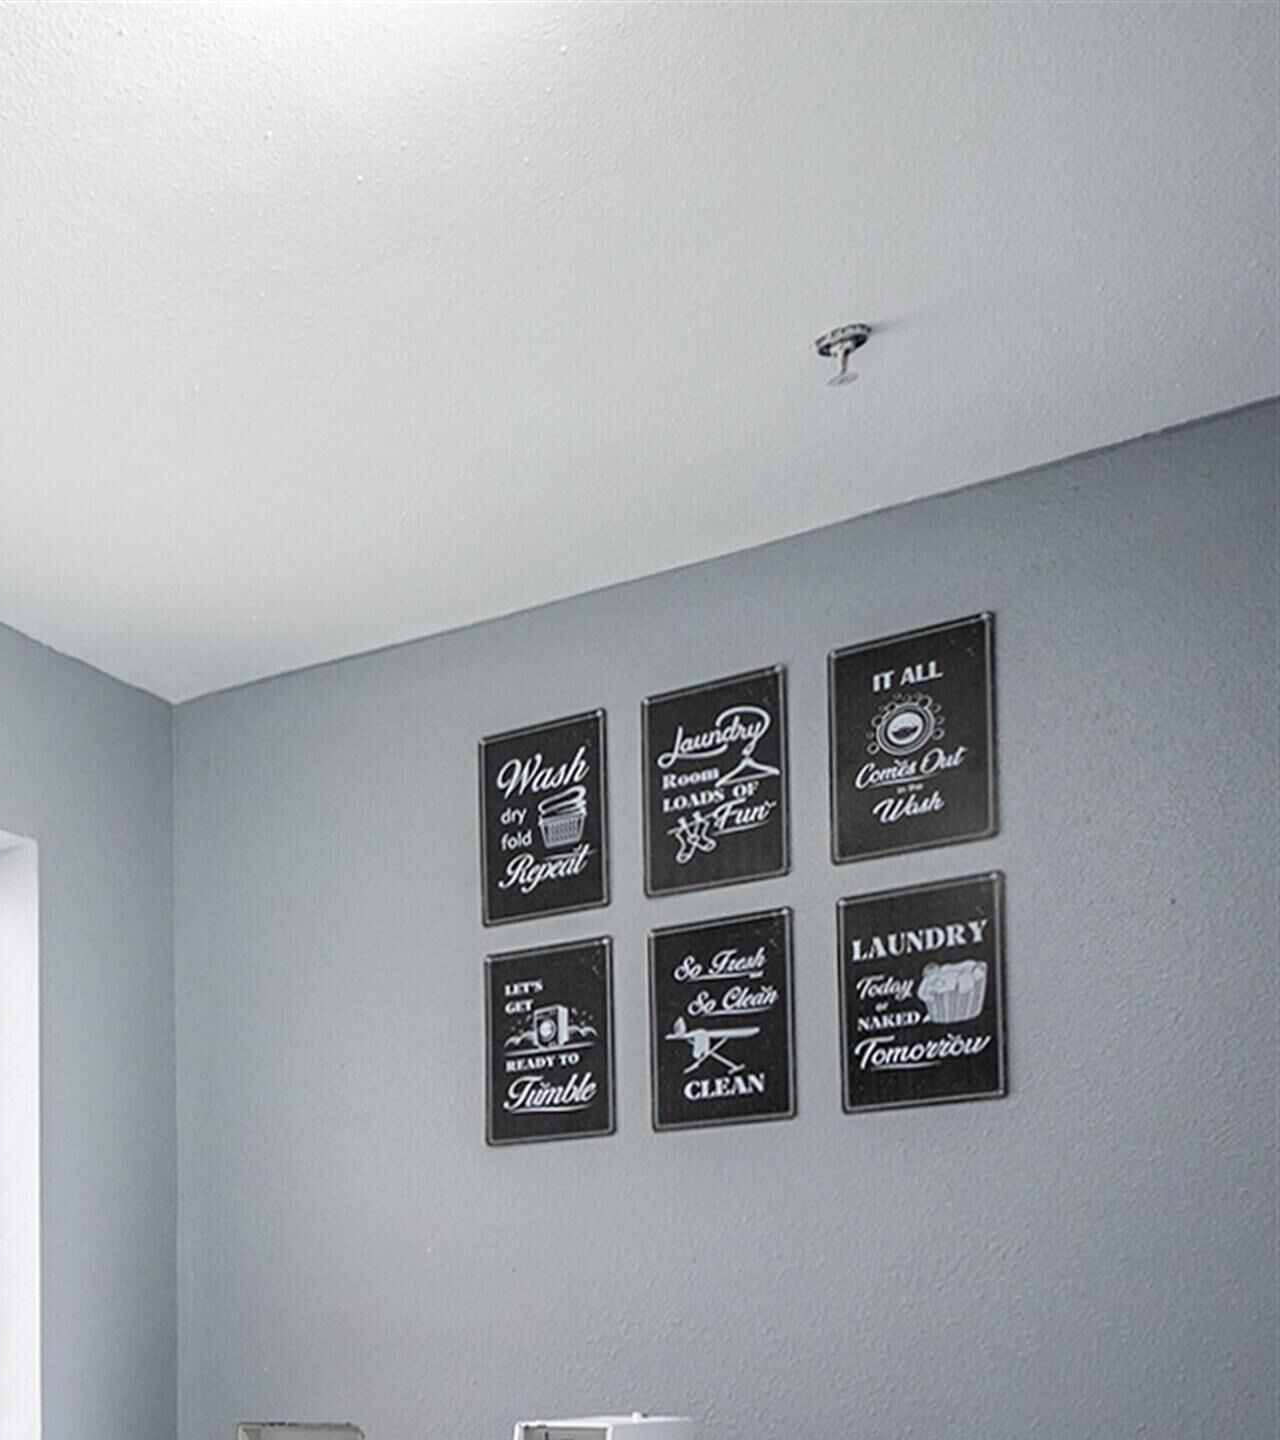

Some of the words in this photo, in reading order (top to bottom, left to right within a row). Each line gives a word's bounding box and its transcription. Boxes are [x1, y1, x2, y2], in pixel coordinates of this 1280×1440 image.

[872, 670, 895, 692] IT
[900, 660, 944, 686] ALL
[657, 705, 771, 768] Laundry
[496, 746, 590, 799] Wash
[662, 768, 720, 790] Room
[855, 760, 917, 789] Comes
[919, 746, 968, 775] Out
[663, 788, 726, 812] LOADS
[732, 781, 759, 798] OF
[872, 790, 945, 823] Wash
[500, 807, 527, 825] dry
[713, 797, 777, 832] Fun
[501, 829, 532, 850] fold
[498, 843, 590, 894] Repeat
[851, 919, 989, 962] LAUNDRY
[673, 955, 703, 981] So
[708, 946, 767, 976] Fresh
[504, 979, 544, 997] LET'S
[687, 990, 717, 1016] So
[722, 985, 778, 1011] Clean
[856, 973, 915, 1000] Today
[504, 1000, 534, 1014] GET
[857, 1010, 921, 1033] NAKED
[505, 1054, 557, 1073] READY
[560, 1052, 580, 1065] TO
[854, 1033, 992, 1070] Tomorrow
[503, 1072, 598, 1110] Tumble
[683, 1072, 766, 1100] CLEAN
